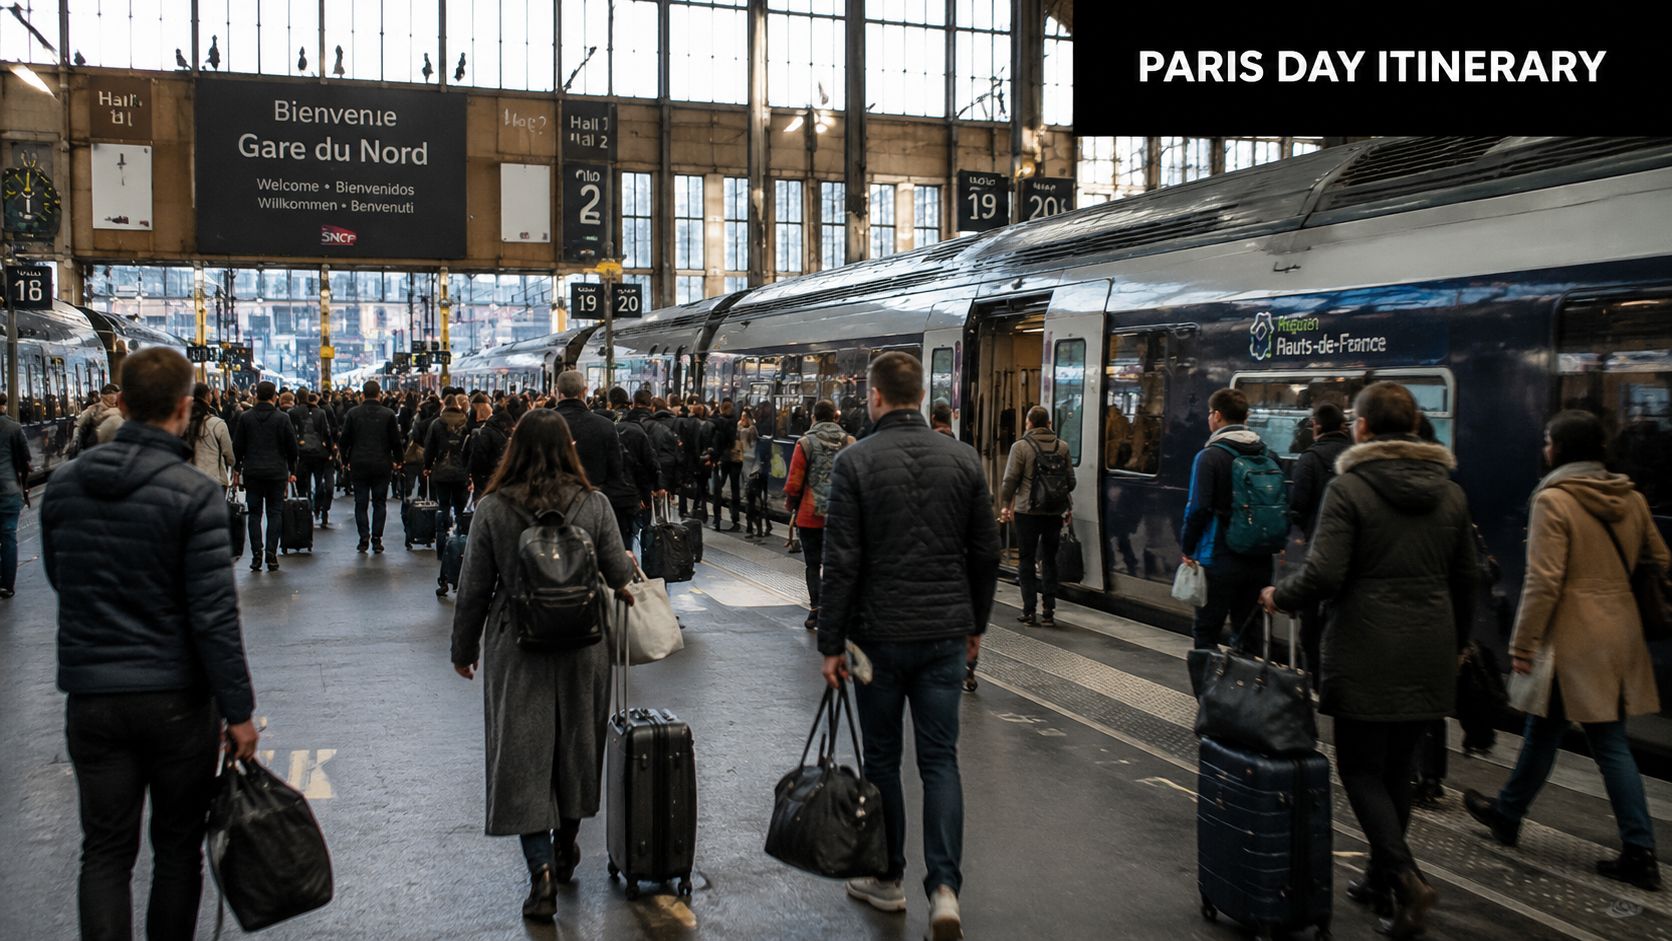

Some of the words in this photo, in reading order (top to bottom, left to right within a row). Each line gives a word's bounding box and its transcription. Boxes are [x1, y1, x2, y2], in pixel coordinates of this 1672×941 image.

[570, 115, 598, 131] Hall
[238, 133, 306, 160] Gare
[314, 136, 350, 162] du
[360, 138, 428, 166] Nord
[256, 178, 320, 192] Welcome
[335, 180, 415, 196] Bienvenidos
[257, 197, 338, 211] Willkommen
[350, 200, 415, 214] Benvenuti
[579, 184, 601, 225] 2
[967, 192, 997, 220] 19
[577, 295, 597, 312] 19
[618, 295, 639, 312] 20
